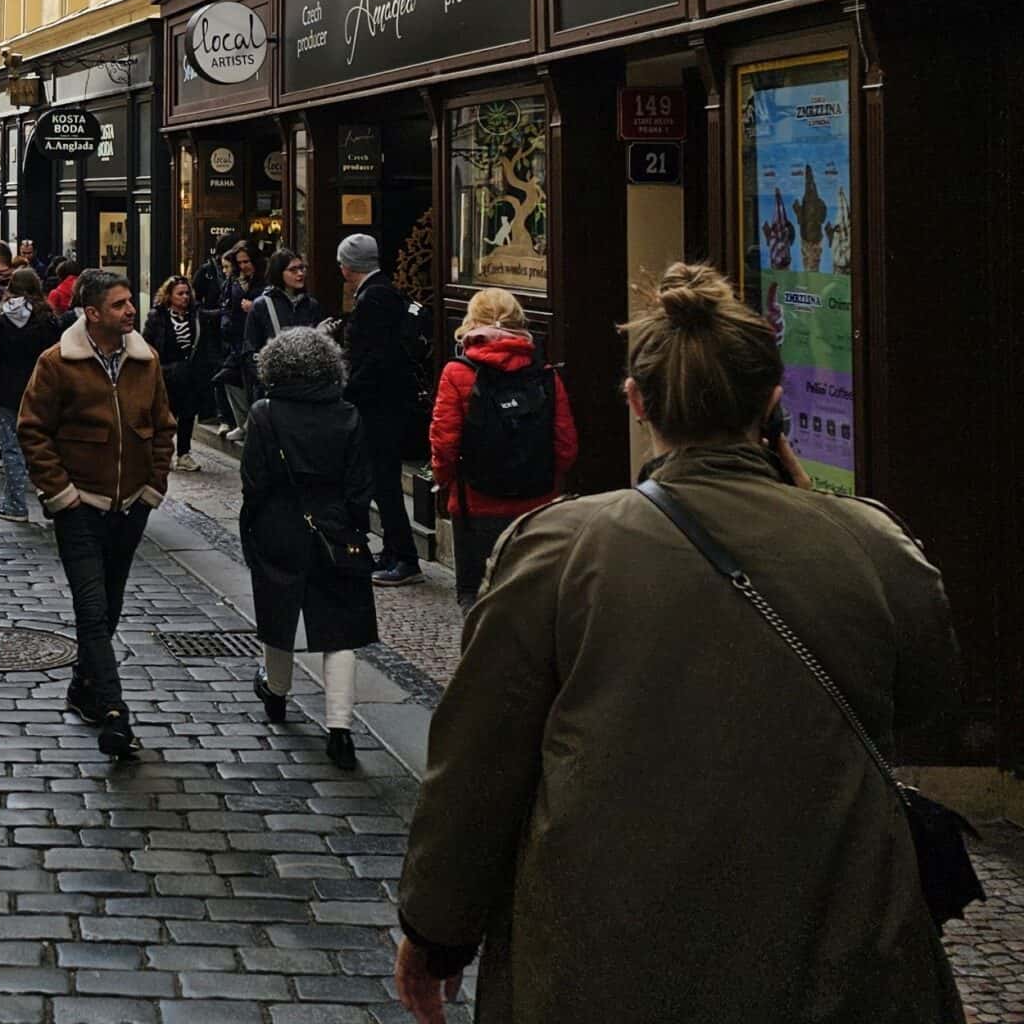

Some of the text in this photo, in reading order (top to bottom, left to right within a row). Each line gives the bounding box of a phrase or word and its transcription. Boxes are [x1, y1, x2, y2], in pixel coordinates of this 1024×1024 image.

[302, 0, 322, 27] Czech
[194, 14, 266, 53] local
[297, 29, 328, 58] producer
[211, 54, 255, 68] ARTISTS
[635, 95, 672, 116] 149
[52, 115, 86, 124] KOSTA
[54, 125, 84, 133] BODA
[45, 141, 94, 152] A.Anglada
[646, 152, 666, 173] 21
